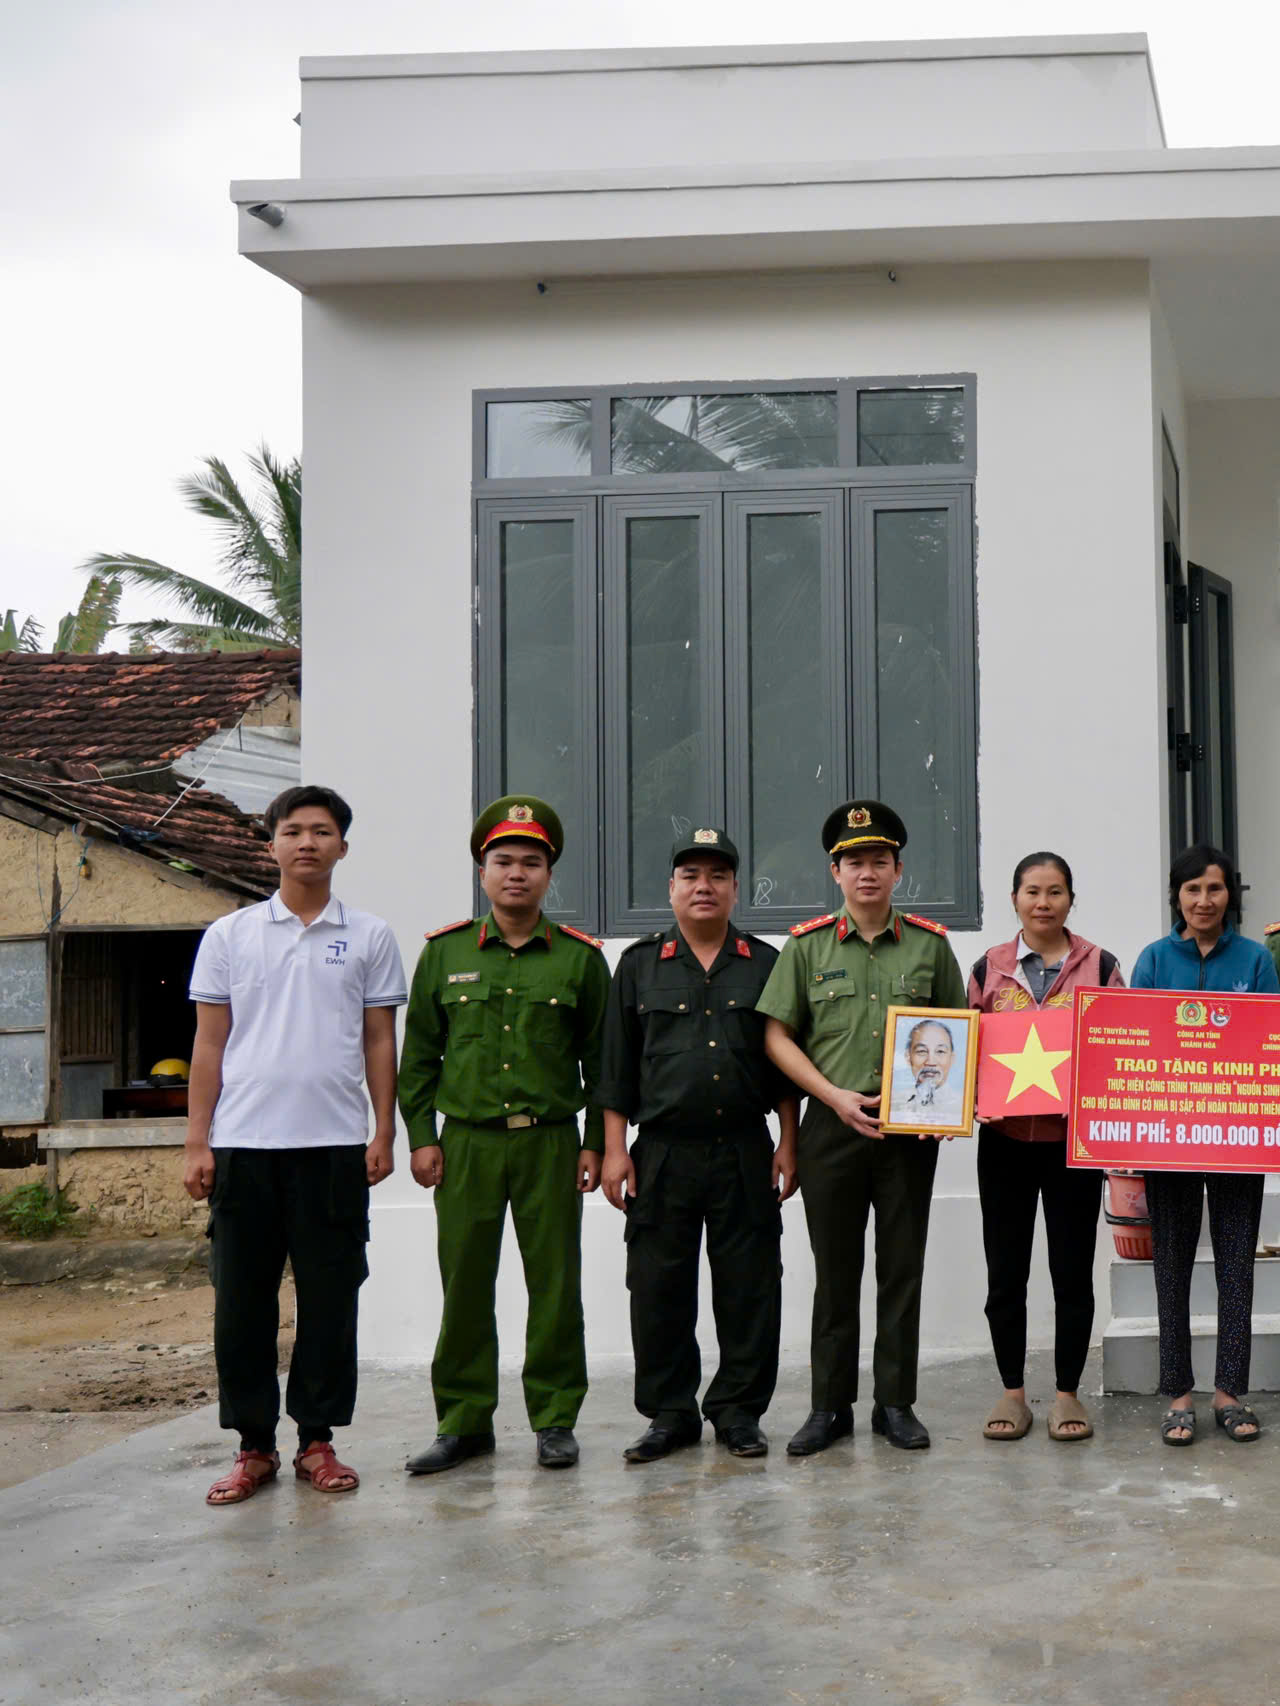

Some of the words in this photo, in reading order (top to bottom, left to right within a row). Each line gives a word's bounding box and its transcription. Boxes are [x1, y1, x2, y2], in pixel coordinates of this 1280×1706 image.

[326, 957, 345, 966] EWH
[1115, 1058, 1157, 1072] TRAO
[1163, 1057, 1207, 1076] TẶNG
[1213, 1062, 1254, 1075] KINH
[1089, 1120, 1131, 1142] KINH
[1137, 1119, 1170, 1143] PHÍ:
[1176, 1124, 1258, 1146] 8.000.000
